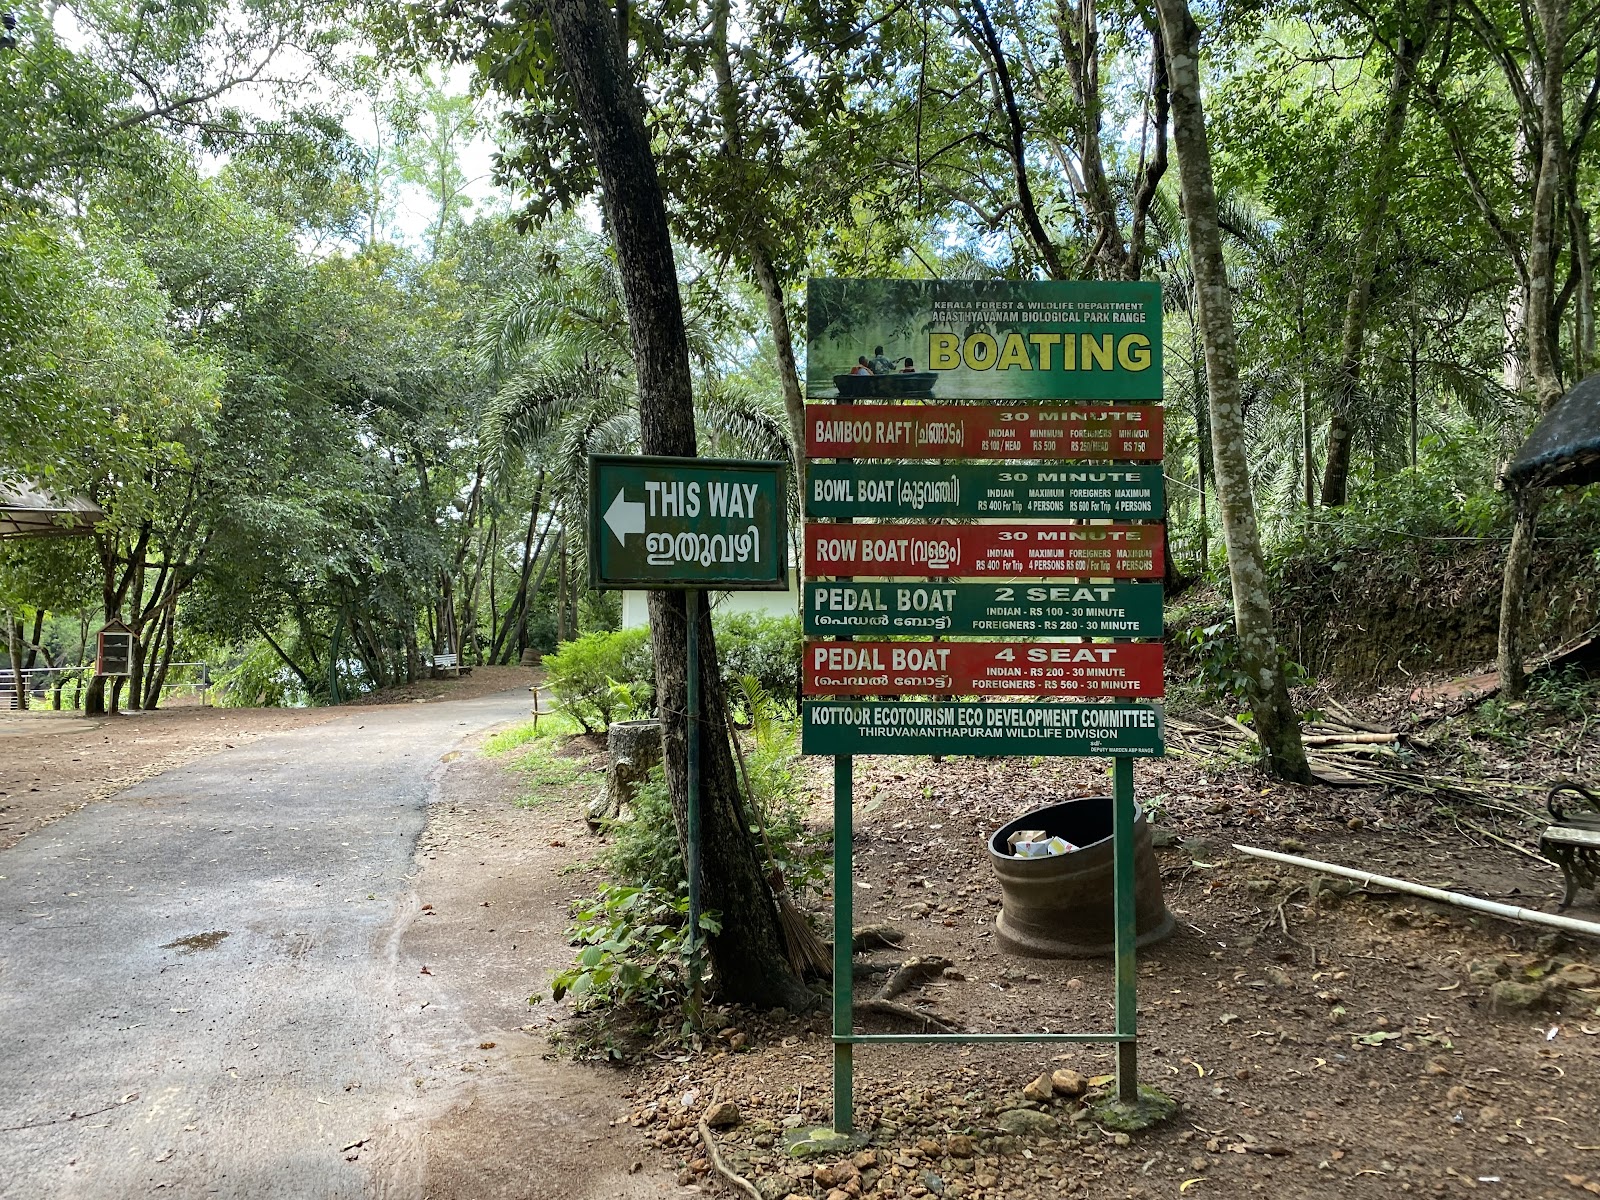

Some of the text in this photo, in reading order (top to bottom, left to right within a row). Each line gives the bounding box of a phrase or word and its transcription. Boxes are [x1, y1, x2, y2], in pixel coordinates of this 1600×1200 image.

[934, 301, 973, 309] KERALA
[975, 302, 1013, 310] FOREST
[1027, 302, 1074, 310] WILDLIFE
[1077, 302, 1144, 310] DEPARTMENT
[932, 311, 1146, 323] AGASTHYAVANAM BIOLOGICAL PARK RANGE
[928, 332, 1152, 372] BOATING
[1000, 412, 1142, 421] 30 MINUTE
[815, 420, 912, 444] BAMBOO RAFT
[988, 429, 1150, 438] INDIAN MINIMUM FOREIGNERS MINIMUM
[981, 440, 989, 451] RS
[1033, 441, 1043, 451] RS
[1044, 441, 1056, 451] 500
[1070, 441, 1079, 452] RS
[1123, 441, 1133, 452] RS
[1133, 441, 1146, 452] 750
[998, 473, 1141, 482] 30 MINUTE
[814, 479, 895, 503] BOWL BOAT
[987, 489, 1151, 498] INDIAN MAXIMUM FOREIGNERS MAXIMUM
[644, 481, 758, 518] THIS WAY
[977, 500, 988, 511] RS
[988, 500, 1002, 511] 400
[1002, 501, 1012, 511] For
[1027, 500, 1032, 511] 4
[1033, 500, 1064, 511] PERSONS
[1069, 501, 1078, 512] RS
[1078, 501, 1090, 512] 600
[1090, 501, 1100, 512] For
[1100, 501, 1112, 514] Trip
[1115, 501, 1120, 512] 4
[1120, 501, 1152, 512] PERSONS
[998, 532, 1141, 541] 30 MINUTE
[645, 525, 760, 568] ഇതുവഴി
[816, 539, 908, 562] ROW BOAT
[987, 549, 1152, 558] INDIAN MAXIMUM FOREIGNERS MAXIMUM
[976, 560, 985, 571] RS
[986, 560, 1000, 571] 400
[1002, 560, 1012, 571] For
[1012, 560, 1023, 572] Trip
[1028, 560, 1034, 571] 4
[1034, 560, 1065, 571] PERSONS
[1066, 560, 1075, 570] RS
[1116, 561, 1121, 571] 4
[1121, 560, 1153, 571] PERSONS
[815, 589, 957, 612] PEDAL BOAT
[995, 588, 1116, 602] 2 SEAT
[986, 607, 1022, 616] INDIAN
[1029, 607, 1043, 616] RS
[1046, 607, 1063, 616] 100
[1071, 607, 1084, 617] 30
[1086, 607, 1125, 617] MINUTE
[972, 621, 1036, 630] FOREIGNERS
[1044, 621, 1058, 630] RS
[1060, 621, 1078, 630] 280
[1086, 621, 1098, 630] 30
[1100, 621, 1140, 631] MINUTE
[814, 648, 951, 671] PEDAL BOAT
[994, 648, 1117, 663] 4 SEAT
[986, 667, 1022, 676] INDIAN
[1030, 667, 1044, 677] RS
[1046, 667, 1064, 677] 200
[1072, 667, 1084, 677] 30
[1086, 667, 1126, 677] MINUTE
[972, 679, 1036, 689] FOREIGNERS
[1044, 680, 1058, 689] RS
[1060, 680, 1078, 689] 560
[1087, 680, 1099, 690] 30
[1101, 680, 1141, 690] MINUTE
[811, 706, 1156, 728] KOTTOOR ECOTOURISM ECO DEVELOPMENT COMMITTEE
[858, 726, 1118, 739] THIRUVANANTHAPURAM WILDLIFE DIVISION
